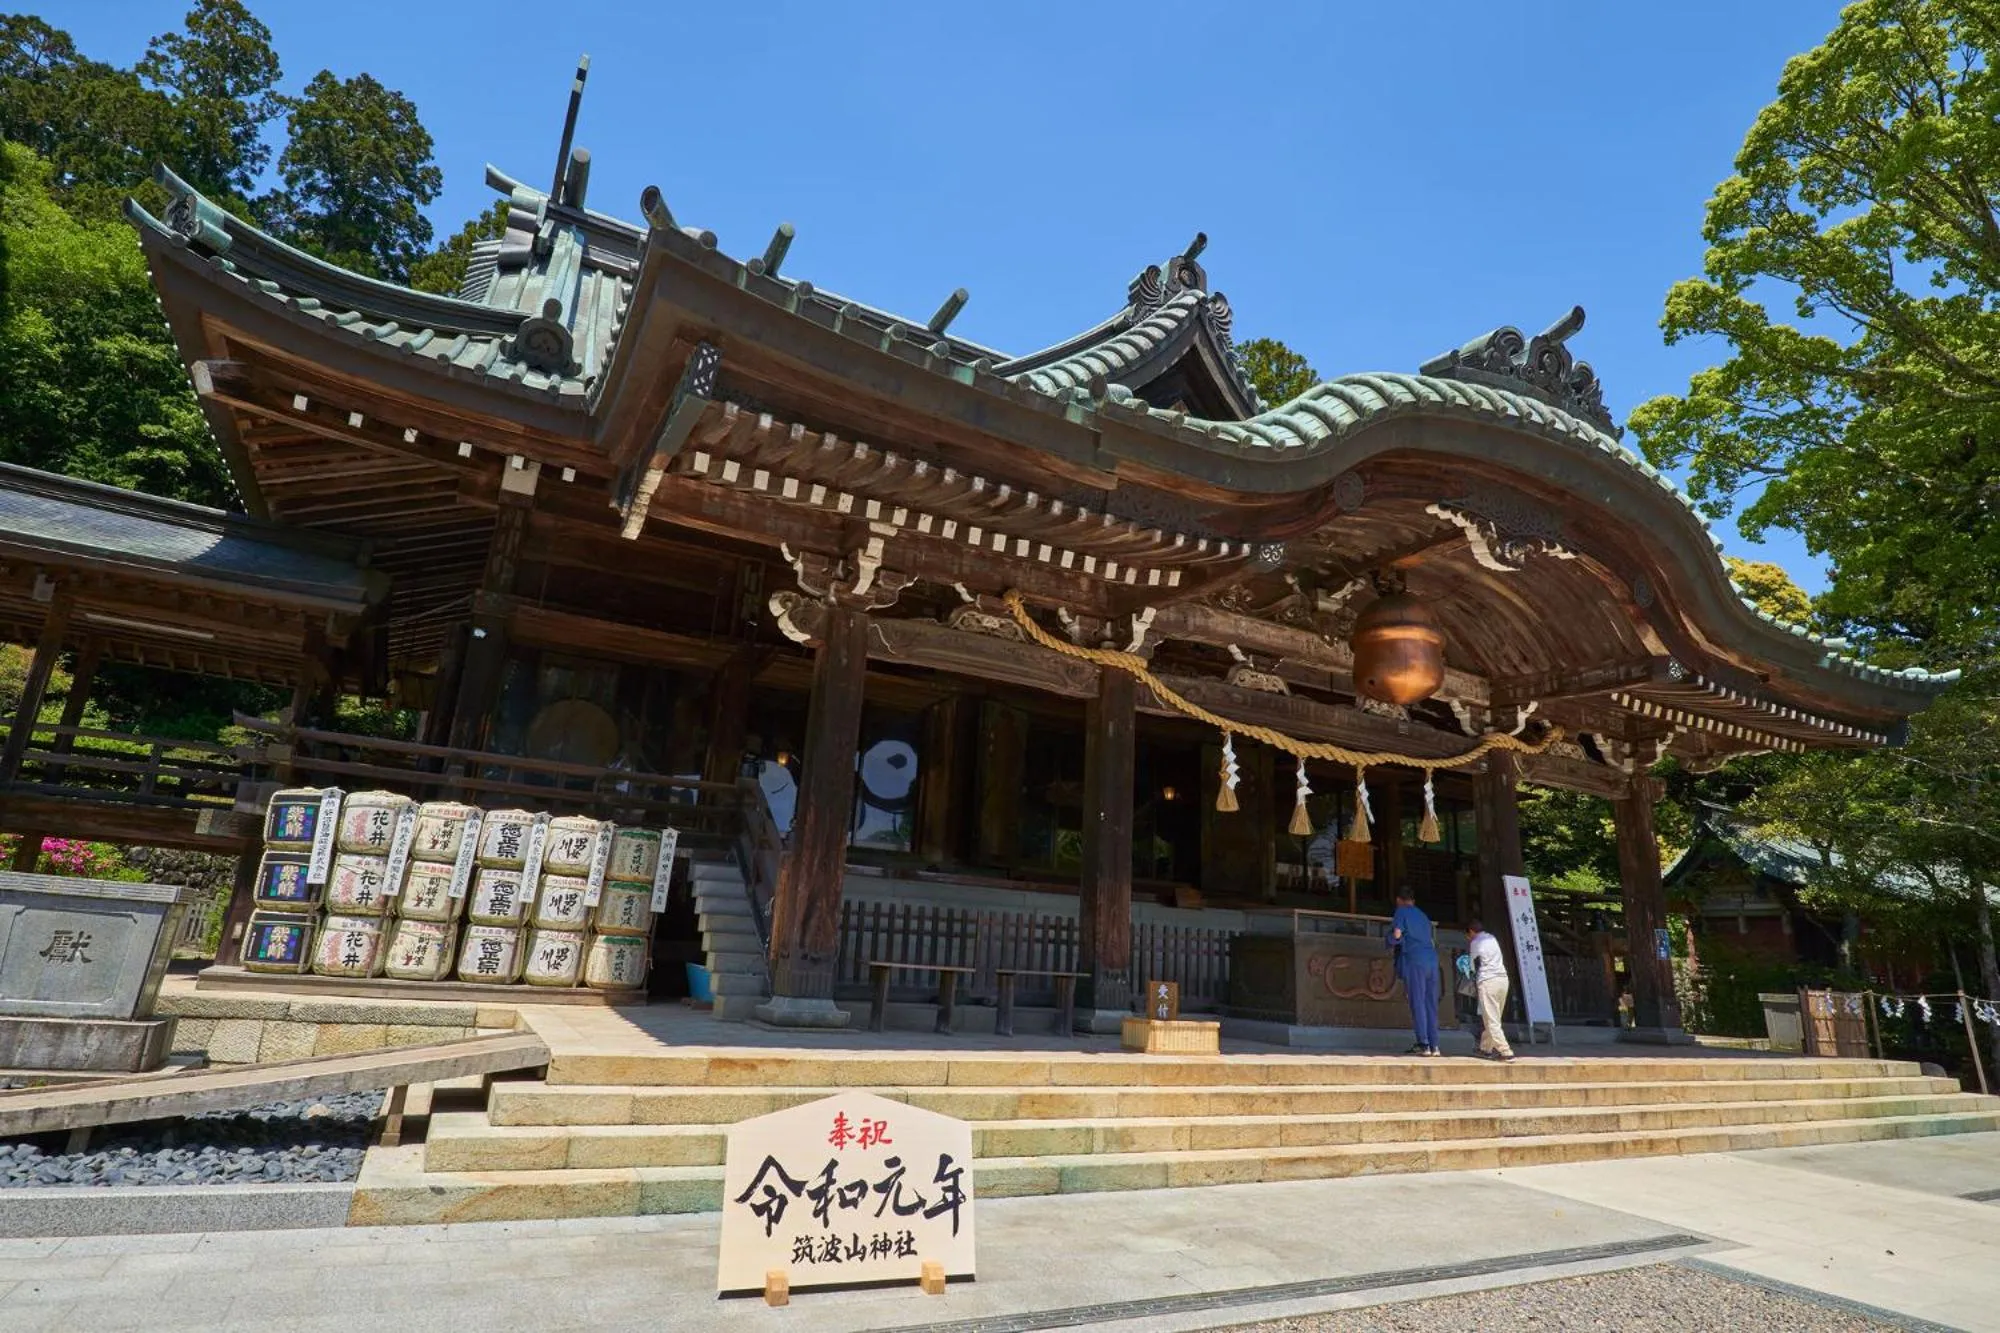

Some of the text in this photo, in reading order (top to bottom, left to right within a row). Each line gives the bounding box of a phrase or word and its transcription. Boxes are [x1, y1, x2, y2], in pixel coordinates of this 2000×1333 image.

[368, 810, 389, 846] 花の井
[439, 819, 456, 851] 副将軍
[355, 869, 377, 906] 花の井
[423, 876, 441, 910] 副将軍
[342, 931, 365, 968] 花の井
[413, 933, 430, 967] 副将軍
[1520, 911, 1535, 953] 令和
[827, 1111, 893, 1151] 奉祝
[733, 1152, 968, 1238] 令和元年
[790, 1230, 919, 1264] 筑波山神社
